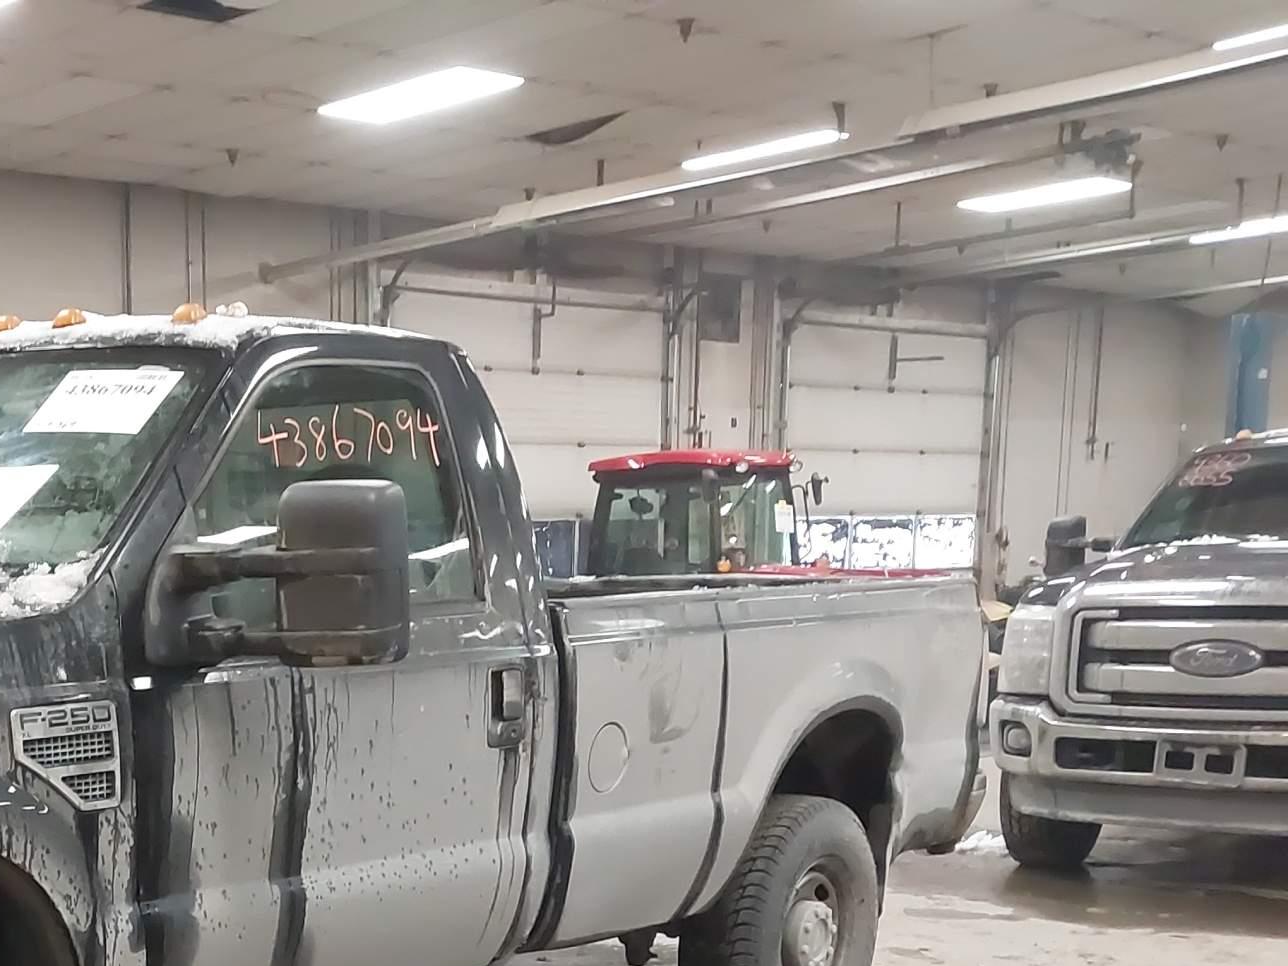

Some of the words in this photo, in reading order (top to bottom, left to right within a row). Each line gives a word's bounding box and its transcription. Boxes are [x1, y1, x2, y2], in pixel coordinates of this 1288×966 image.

[257, 404, 440, 468] 43867094
[1190, 647, 1239, 667] Ford
[65, 725, 91, 733] SUPER
